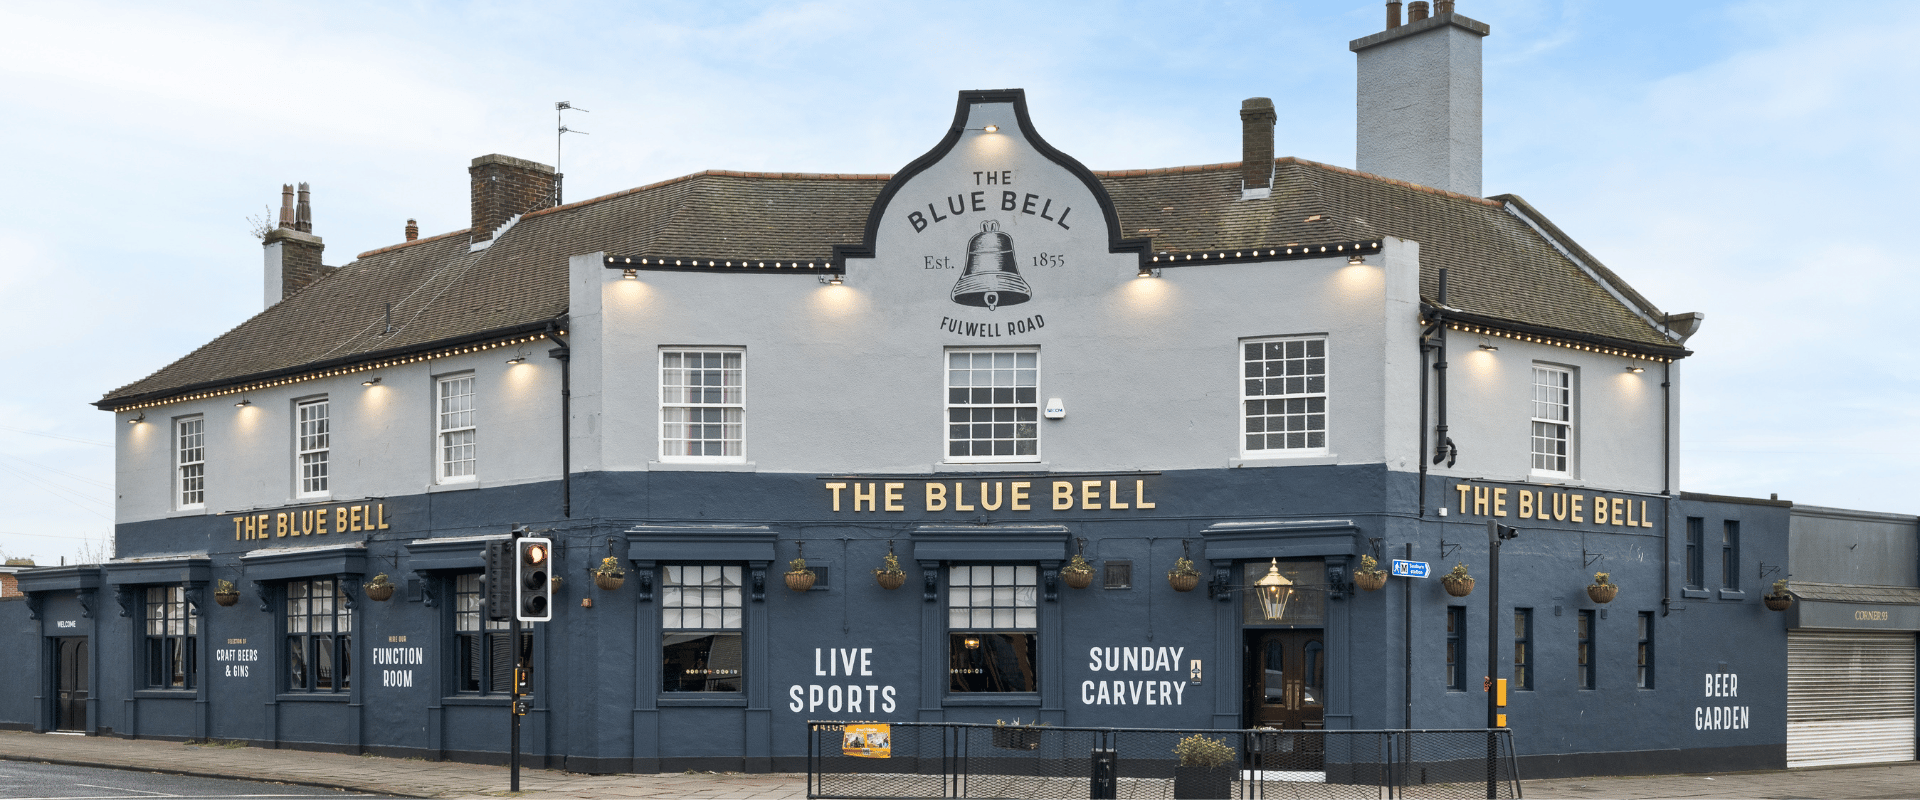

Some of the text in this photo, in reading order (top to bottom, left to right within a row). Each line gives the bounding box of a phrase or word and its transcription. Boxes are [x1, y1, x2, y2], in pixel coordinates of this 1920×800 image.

[973, 171, 1011, 185] THE
[907, 190, 1072, 233] BLUE BELL
[924, 255, 955, 270] Est.
[1032, 253, 1065, 268] 1855
[940, 314, 1045, 337] FULWELL ROAD
[826, 480, 1155, 511] THE BLUE BELL
[1456, 484, 1653, 528] THE BLUE BELL
[233, 504, 389, 541] THE BLUE BELL
[57, 620, 76, 628] WELCOME
[216, 649, 258, 661] CRAFT BEERS
[373, 647, 423, 665] FUNCTION
[815, 647, 873, 676] LIVE
[1089, 646, 1185, 671] SUNDAY
[225, 665, 249, 677] & GINS
[383, 670, 412, 687] ROOM
[1081, 679, 1187, 705] CARVERY
[1705, 673, 1738, 697] BEER
[789, 684, 897, 713] SPORTS
[1695, 706, 1749, 730] GARDEN
